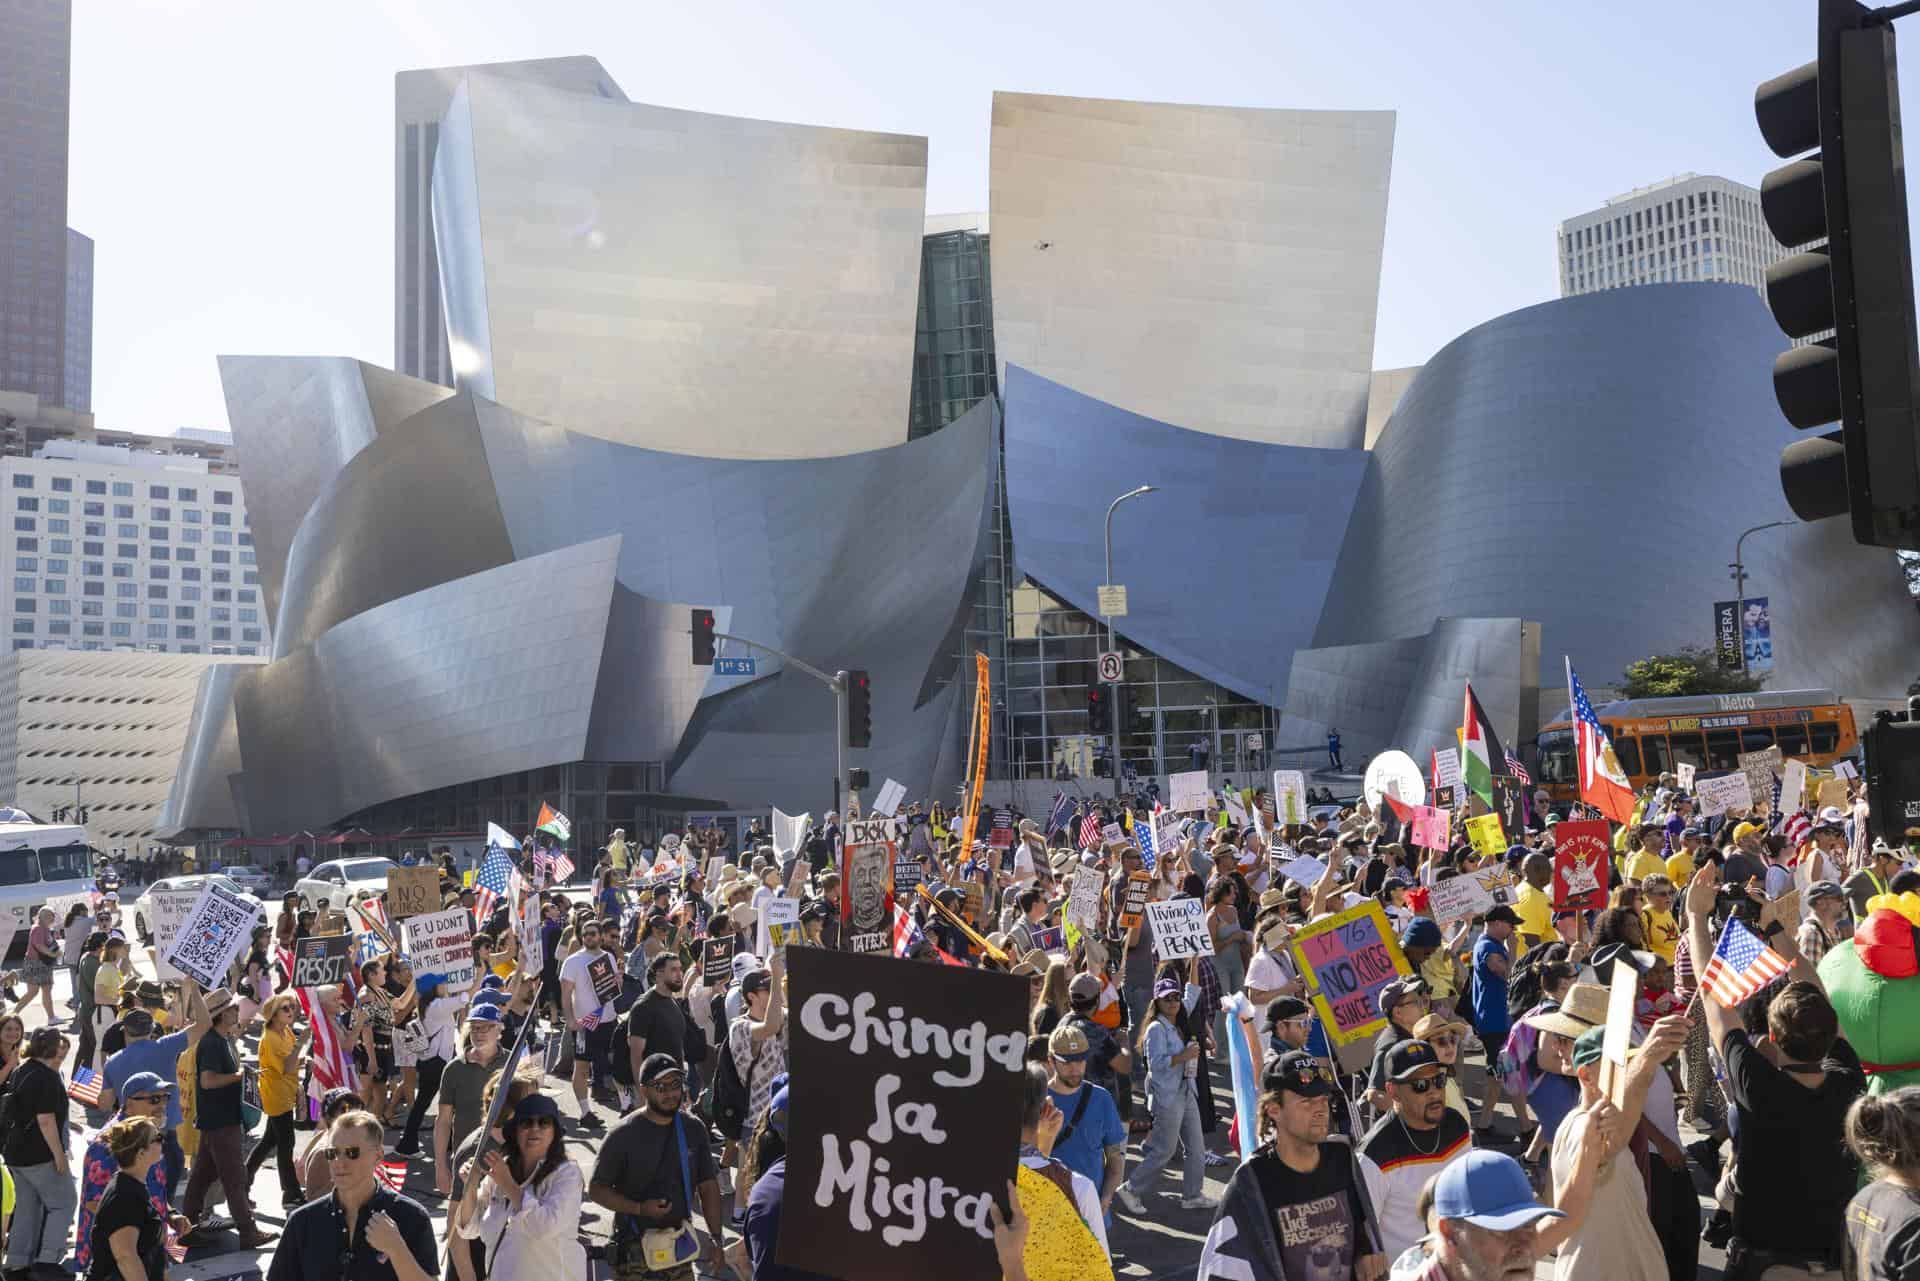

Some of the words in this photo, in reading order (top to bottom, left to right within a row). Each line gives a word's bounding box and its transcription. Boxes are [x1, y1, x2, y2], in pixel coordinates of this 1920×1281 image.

[736, 661, 751, 672] St
[1719, 695, 1755, 710] Metro
[852, 820, 889, 842] DICK
[398, 885, 426, 899] NO
[409, 923, 421, 937] IF
[424, 919, 434, 934] U
[409, 937, 434, 953] WANT
[850, 931, 888, 953] TATER
[1163, 934, 1212, 956] PEACE
[296, 954, 345, 986] RESIST
[413, 957, 422, 970] IN
[424, 953, 441, 968] THE
[1321, 961, 1358, 999] NO
[1351, 943, 1393, 985] KINGS
[1333, 996, 1374, 1026] SINCE
[800, 992, 1027, 1087] Chinga
[814, 1133, 994, 1246] Migra
[1294, 1196, 1337, 1217] TASTED
[1281, 1217, 1309, 1235] LIKE
